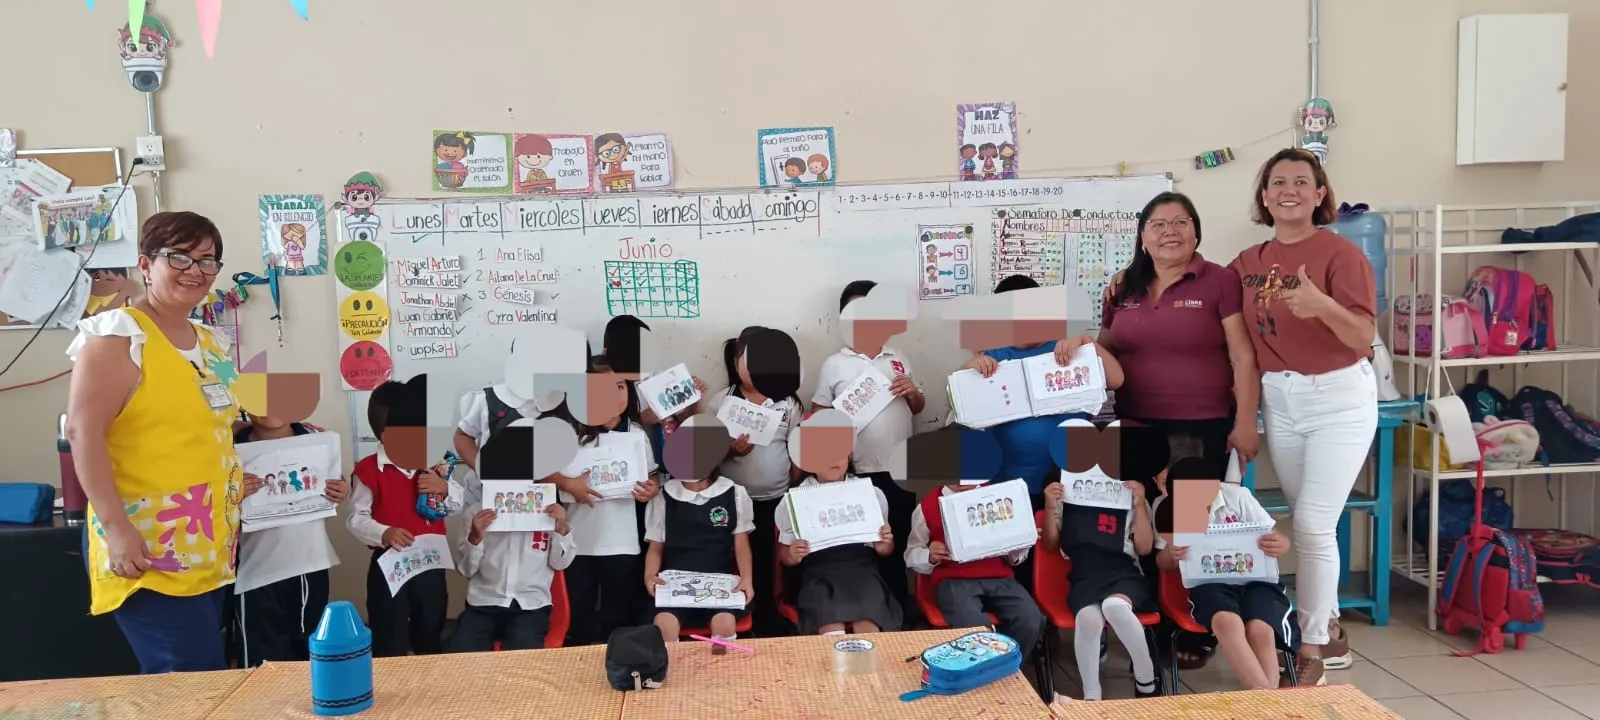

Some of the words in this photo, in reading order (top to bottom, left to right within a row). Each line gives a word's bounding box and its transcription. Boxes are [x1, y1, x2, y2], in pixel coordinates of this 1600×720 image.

[975, 110, 1000, 121] HAZ
[971, 123, 985, 134] UNA
[988, 123, 1005, 134] FILA
[269, 201, 316, 210] TRABAJA
[272, 212, 282, 222] EN
[392, 204, 442, 229] Lunes
[446, 205, 499, 229] Martes
[652, 203, 699, 224] iernes
[1007, 206, 1058, 219] Semaforo
[1080, 208, 1136, 220] Conductas
[1002, 218, 1045, 231] Nombres
[496, 247, 515, 262] Ana
[517, 247, 541, 262] Elisa
[618, 237, 673, 259] Junio
[396, 257, 429, 274] Miguel
[431, 256, 460, 271] Arturo
[397, 273, 435, 287] Dominick
[488, 269, 514, 284] Aitana
[515, 270, 525, 283] De
[525, 269, 536, 282] La
[400, 291, 434, 305] Jonathan
[494, 286, 532, 303] Génesis
[423, 308, 458, 321] Gabriel
[487, 308, 514, 325] Cyra
[515, 308, 557, 323] Valentina
[407, 322, 452, 336] Armando
